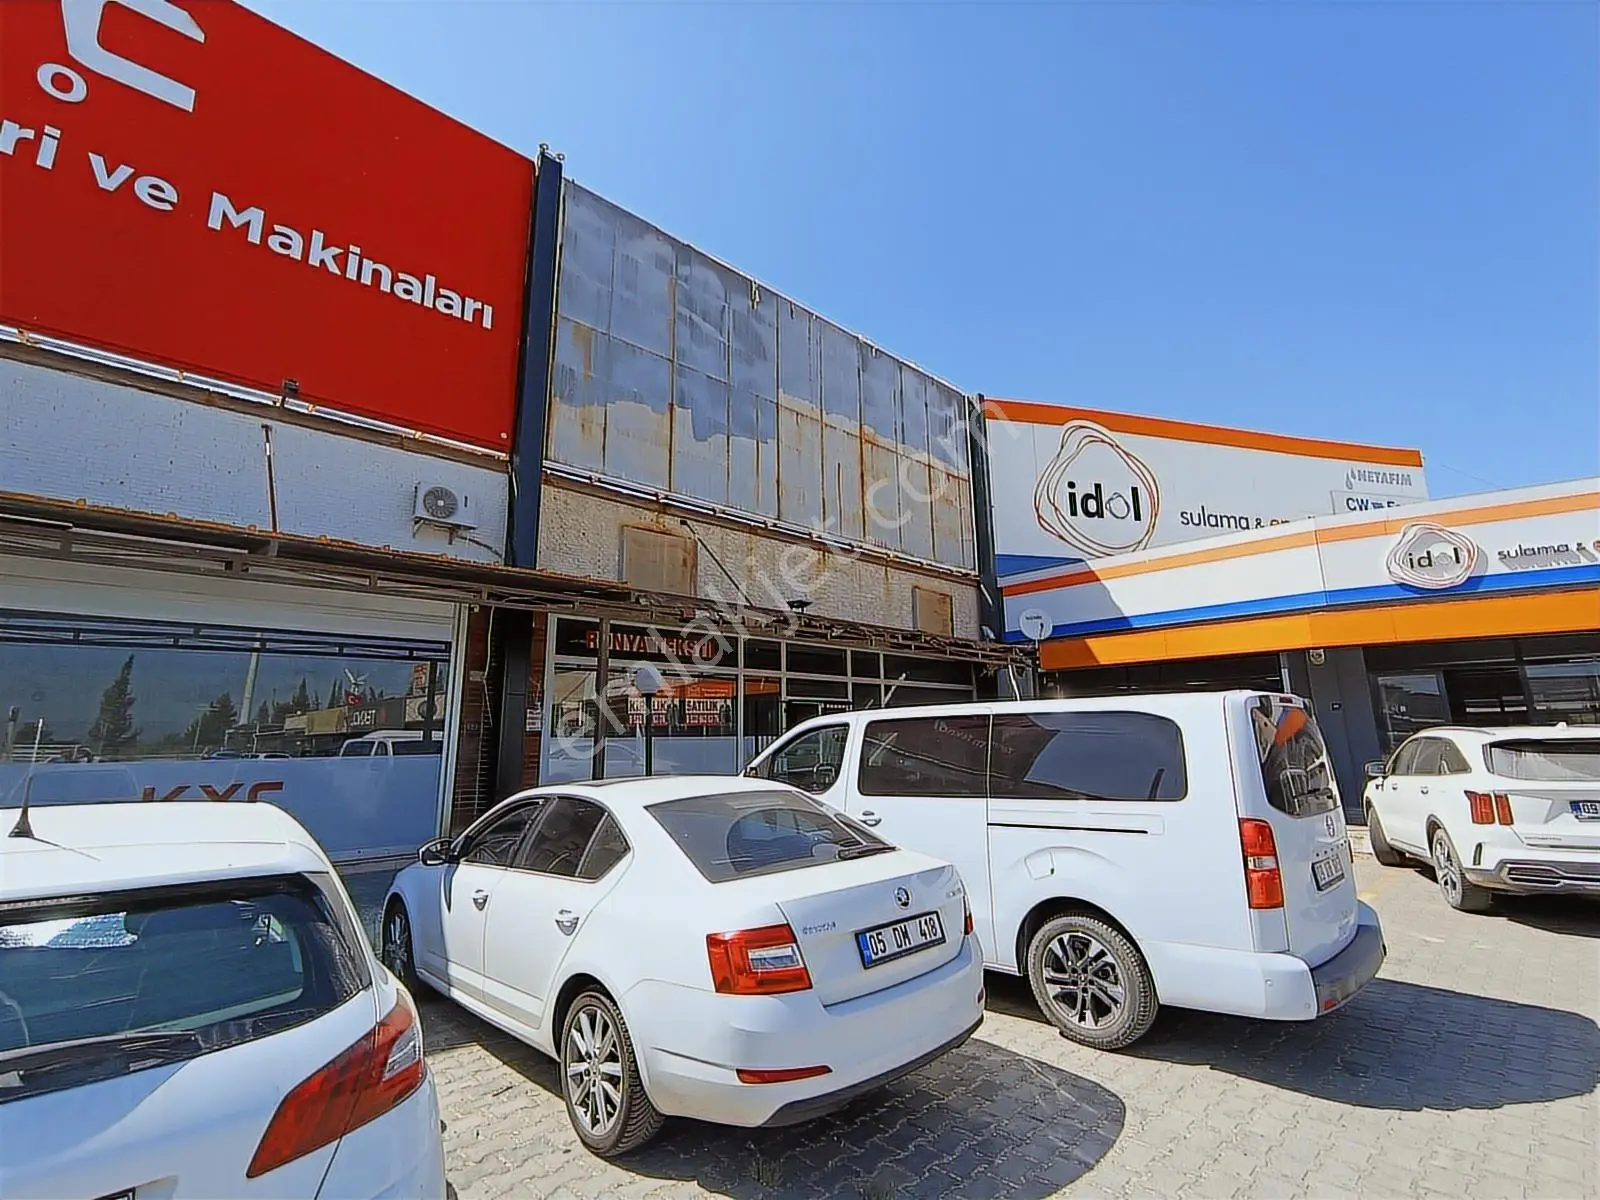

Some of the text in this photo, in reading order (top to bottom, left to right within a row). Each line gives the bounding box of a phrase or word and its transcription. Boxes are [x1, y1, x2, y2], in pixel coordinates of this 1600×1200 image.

[88, 151, 180, 211] ve
[206, 190, 494, 330] Makinaları
[1067, 480, 1143, 522] idol
[1180, 505, 1250, 530] sulama
[1407, 546, 1462, 570] idol
[1497, 543, 1570, 560] sulama
[868, 931, 887, 956] 05
[919, 917, 938, 942] 418
